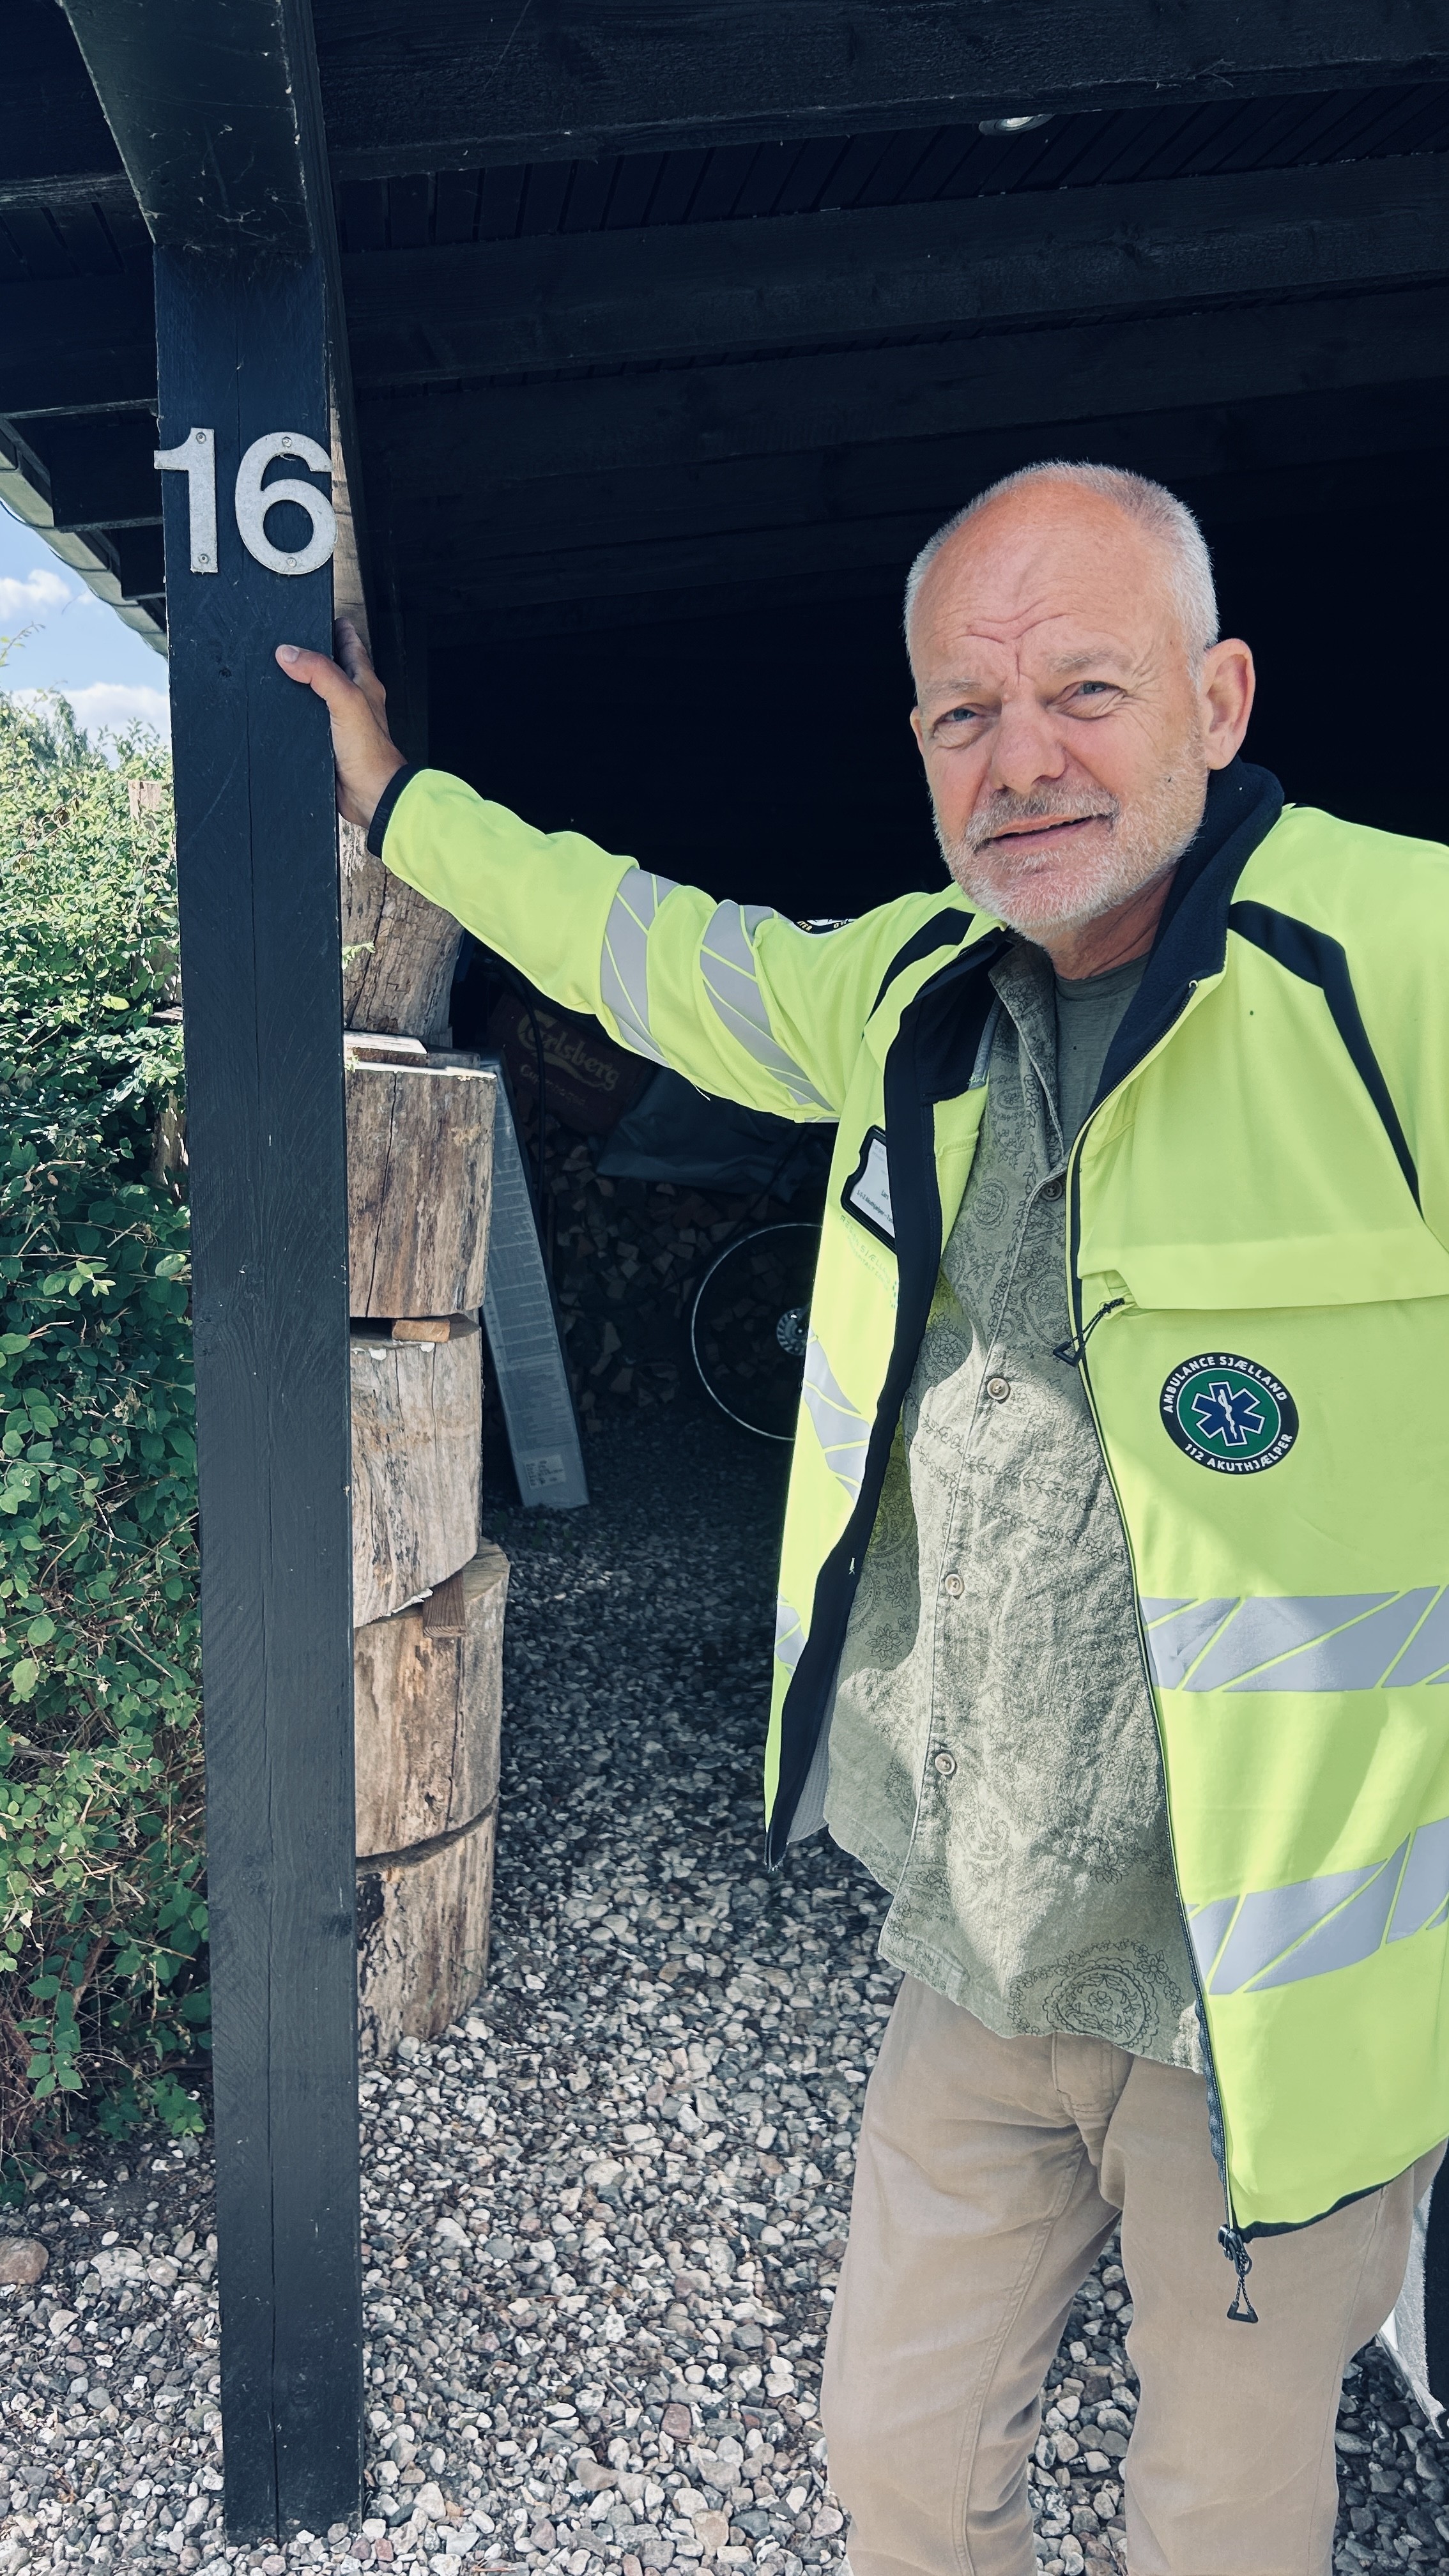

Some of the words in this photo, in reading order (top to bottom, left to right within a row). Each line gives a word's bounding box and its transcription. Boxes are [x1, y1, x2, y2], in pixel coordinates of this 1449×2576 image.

[154, 427, 338, 576] 16
[518, 1009, 620, 1091] Carlsberg
[1163, 1356, 1216, 1413] AMBULANCE
[1219, 1356, 1287, 1401] SJÆLLAND
[1184, 1443, 1204, 1461] 112
[1206, 1434, 1293, 1472] AKUTHJÆLPER
